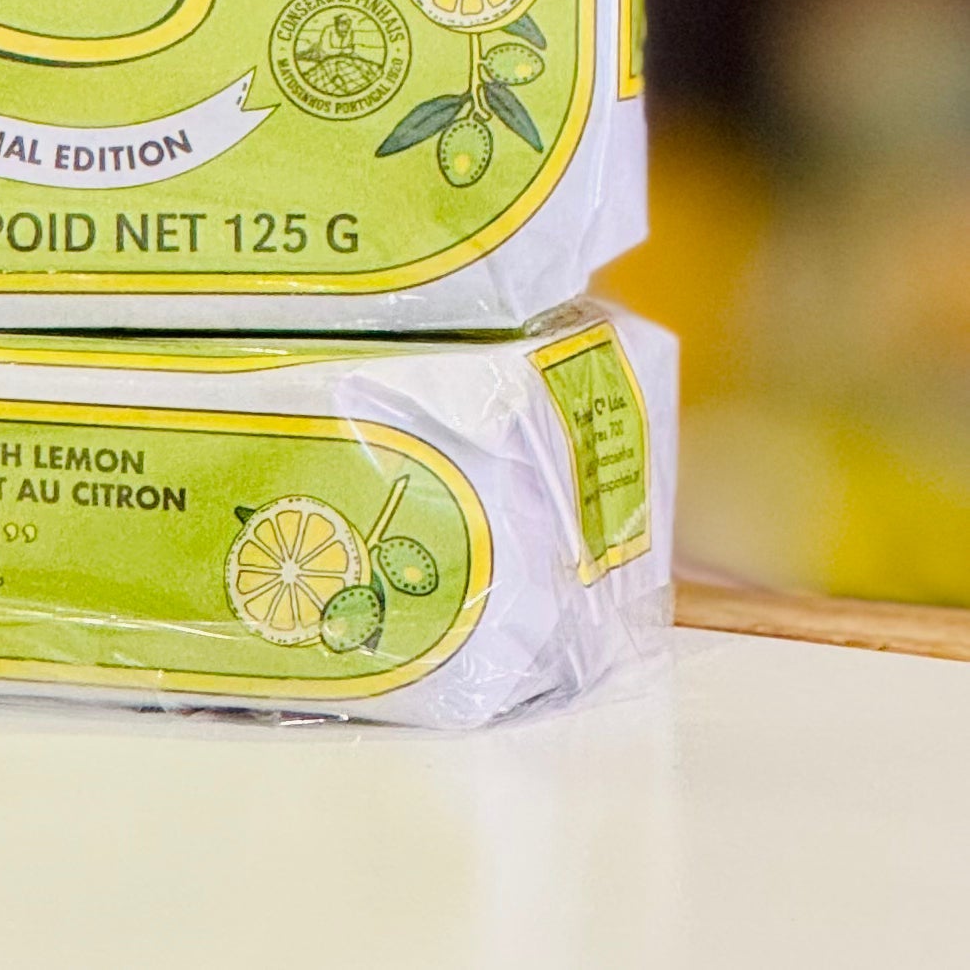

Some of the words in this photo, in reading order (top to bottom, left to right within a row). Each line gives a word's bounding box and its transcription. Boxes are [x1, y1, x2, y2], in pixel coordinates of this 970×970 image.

[335, 83, 391, 114] PORTUGAL
[54, 129, 193, 172] EDITION
[116, 212, 207, 253] NET
[224, 212, 308, 253] 125
[326, 213, 360, 254] G
[34, 444, 145, 475] LEMON
[15, 478, 61, 505] AU
[71, 480, 187, 512] CITRON
